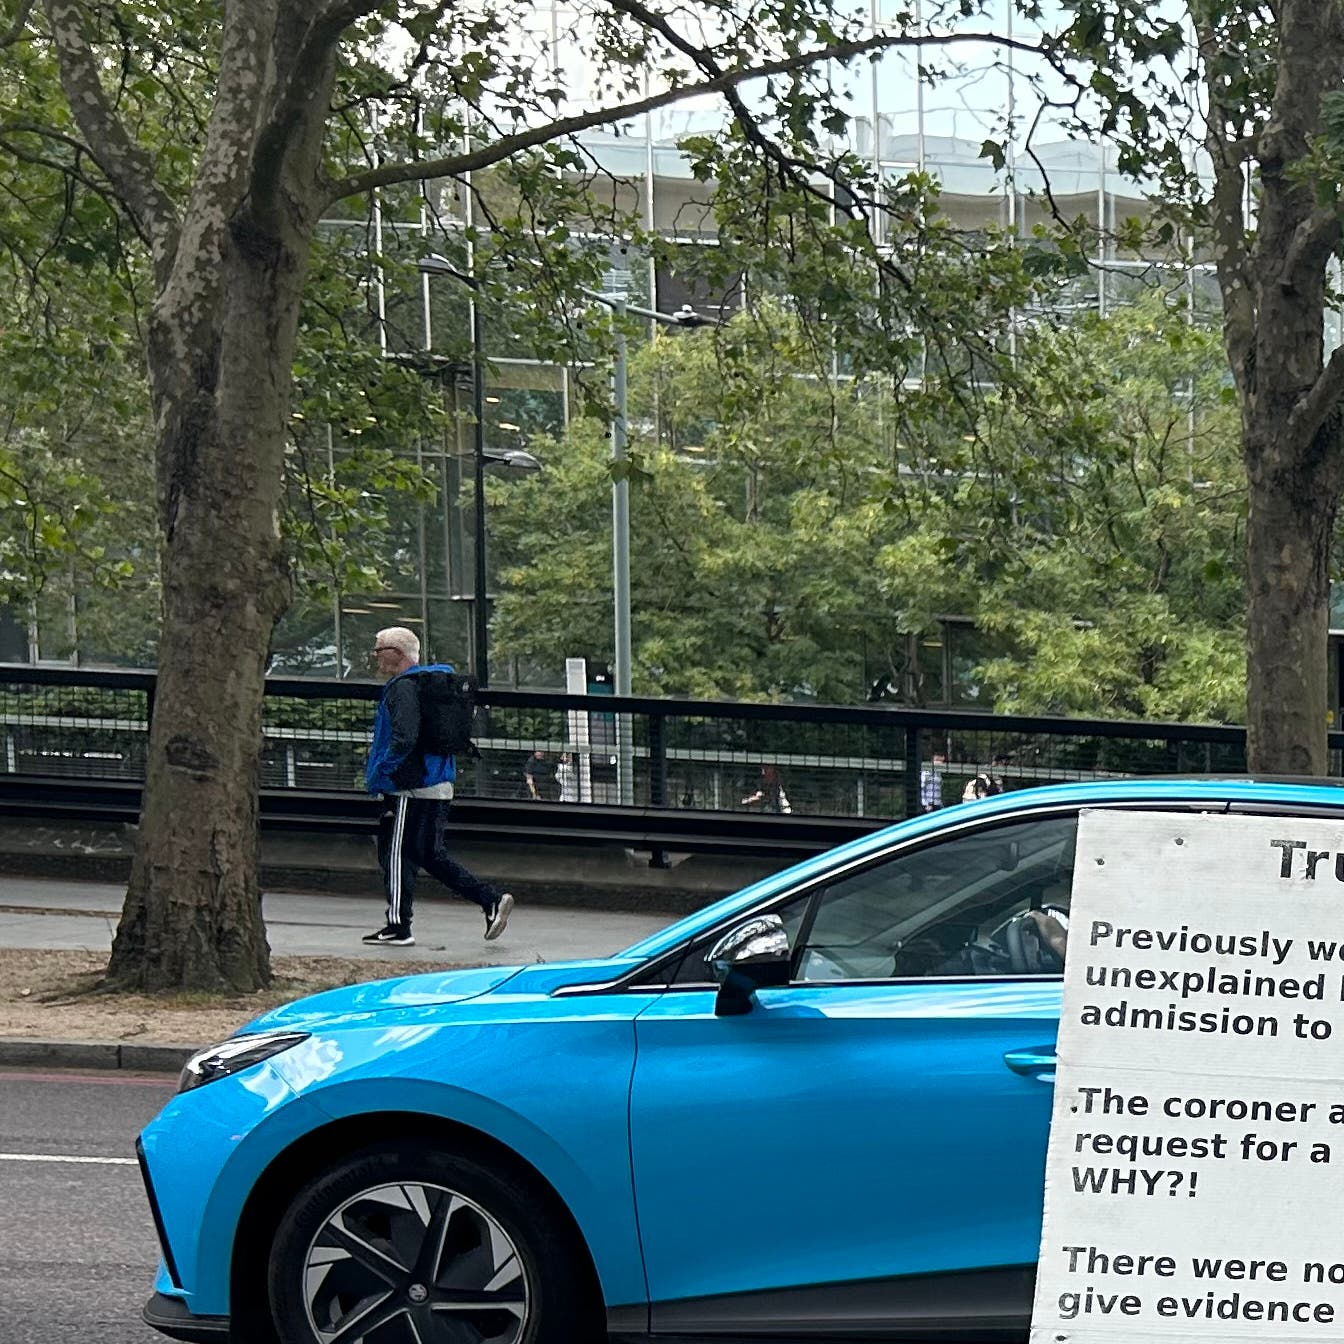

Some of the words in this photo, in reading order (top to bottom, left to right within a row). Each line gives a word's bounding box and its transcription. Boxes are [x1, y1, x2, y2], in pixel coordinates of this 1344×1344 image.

[1090, 921, 1293, 965] Previously
[1086, 966, 1325, 1000] unexplained
[1081, 1001, 1278, 1036] admission
[1293, 1014, 1332, 1040] to
[1078, 1088, 1148, 1115] The
[1163, 1097, 1316, 1122] coroner
[1075, 1134, 1227, 1162] request
[1240, 1134, 1297, 1161] for
[1310, 1143, 1330, 1163] a
[1072, 1167, 1197, 1197] WHY?!
[1062, 1246, 1176, 1277] There
[1192, 1258, 1287, 1281] were
[1058, 1287, 1141, 1319] give
[1157, 1292, 1334, 1323] evidence
